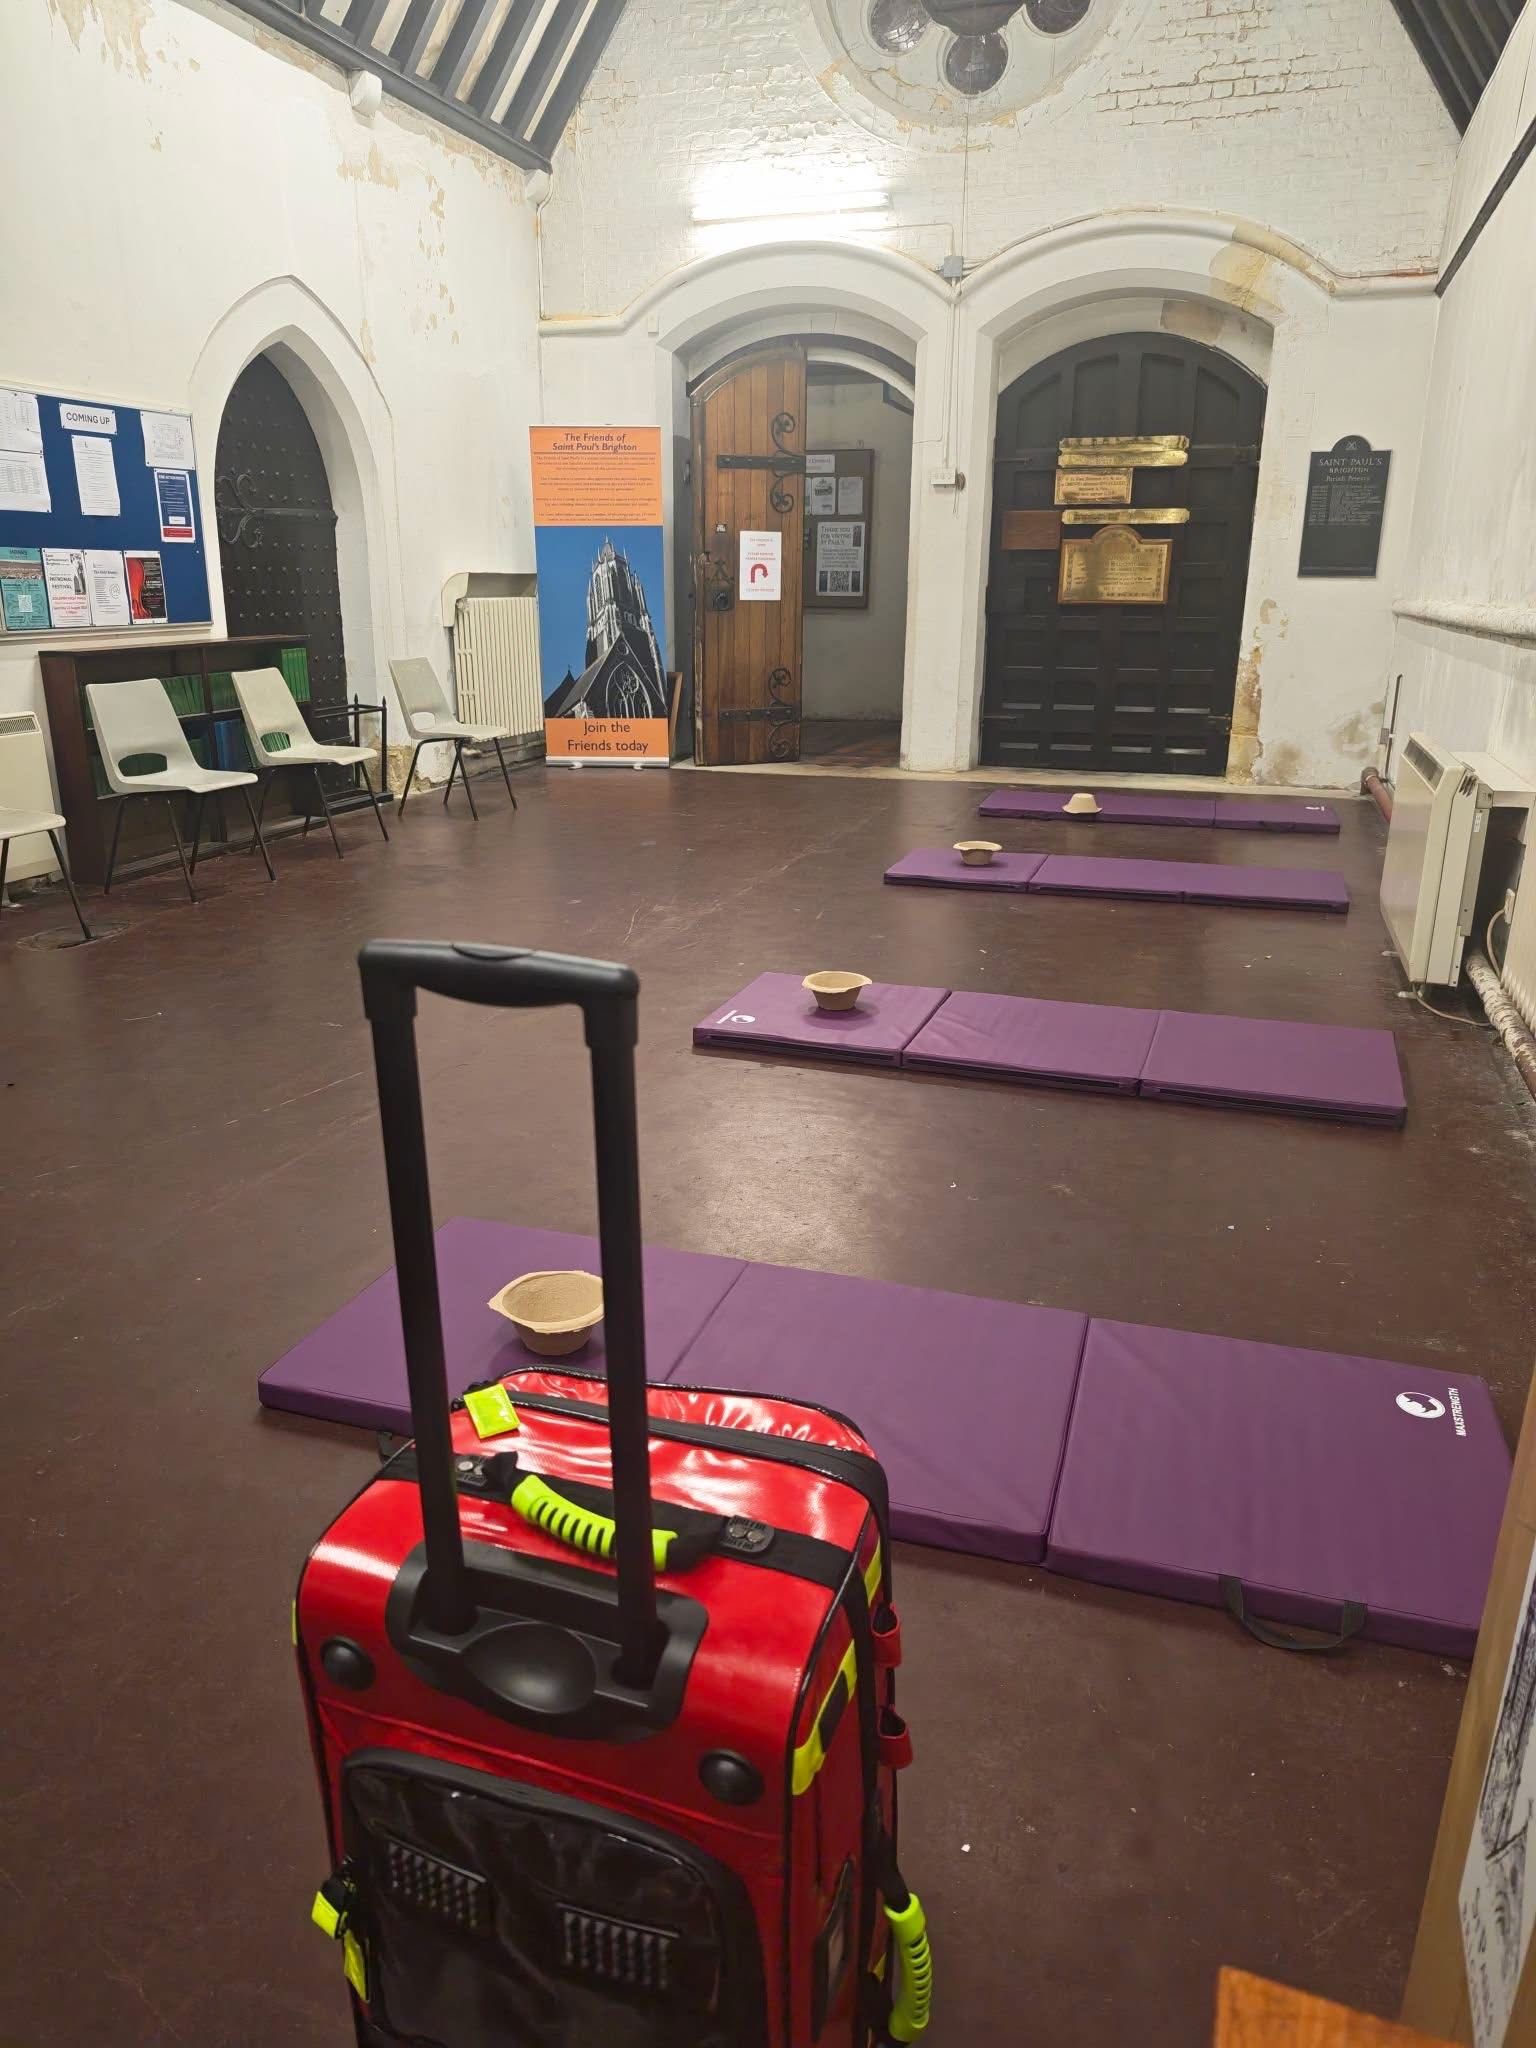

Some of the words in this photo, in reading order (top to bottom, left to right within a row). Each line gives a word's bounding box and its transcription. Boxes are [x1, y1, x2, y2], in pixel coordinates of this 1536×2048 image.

[65, 412, 99, 424] COMING
[100, 416, 110, 425] UP
[565, 433, 581, 441] The
[583, 433, 614, 442] Friends
[616, 433, 627, 443] of
[552, 442, 574, 451] Saint
[576, 442, 600, 451] Paul's
[601, 443, 637, 453] Brighton
[1320, 458, 1345, 466] SAINT
[583, 721, 607, 736] Join
[611, 722, 631, 733] the
[567, 739, 612, 751] Friends
[615, 740, 649, 754] today
[1447, 1387, 1467, 1437] MAXSTRENGTH
